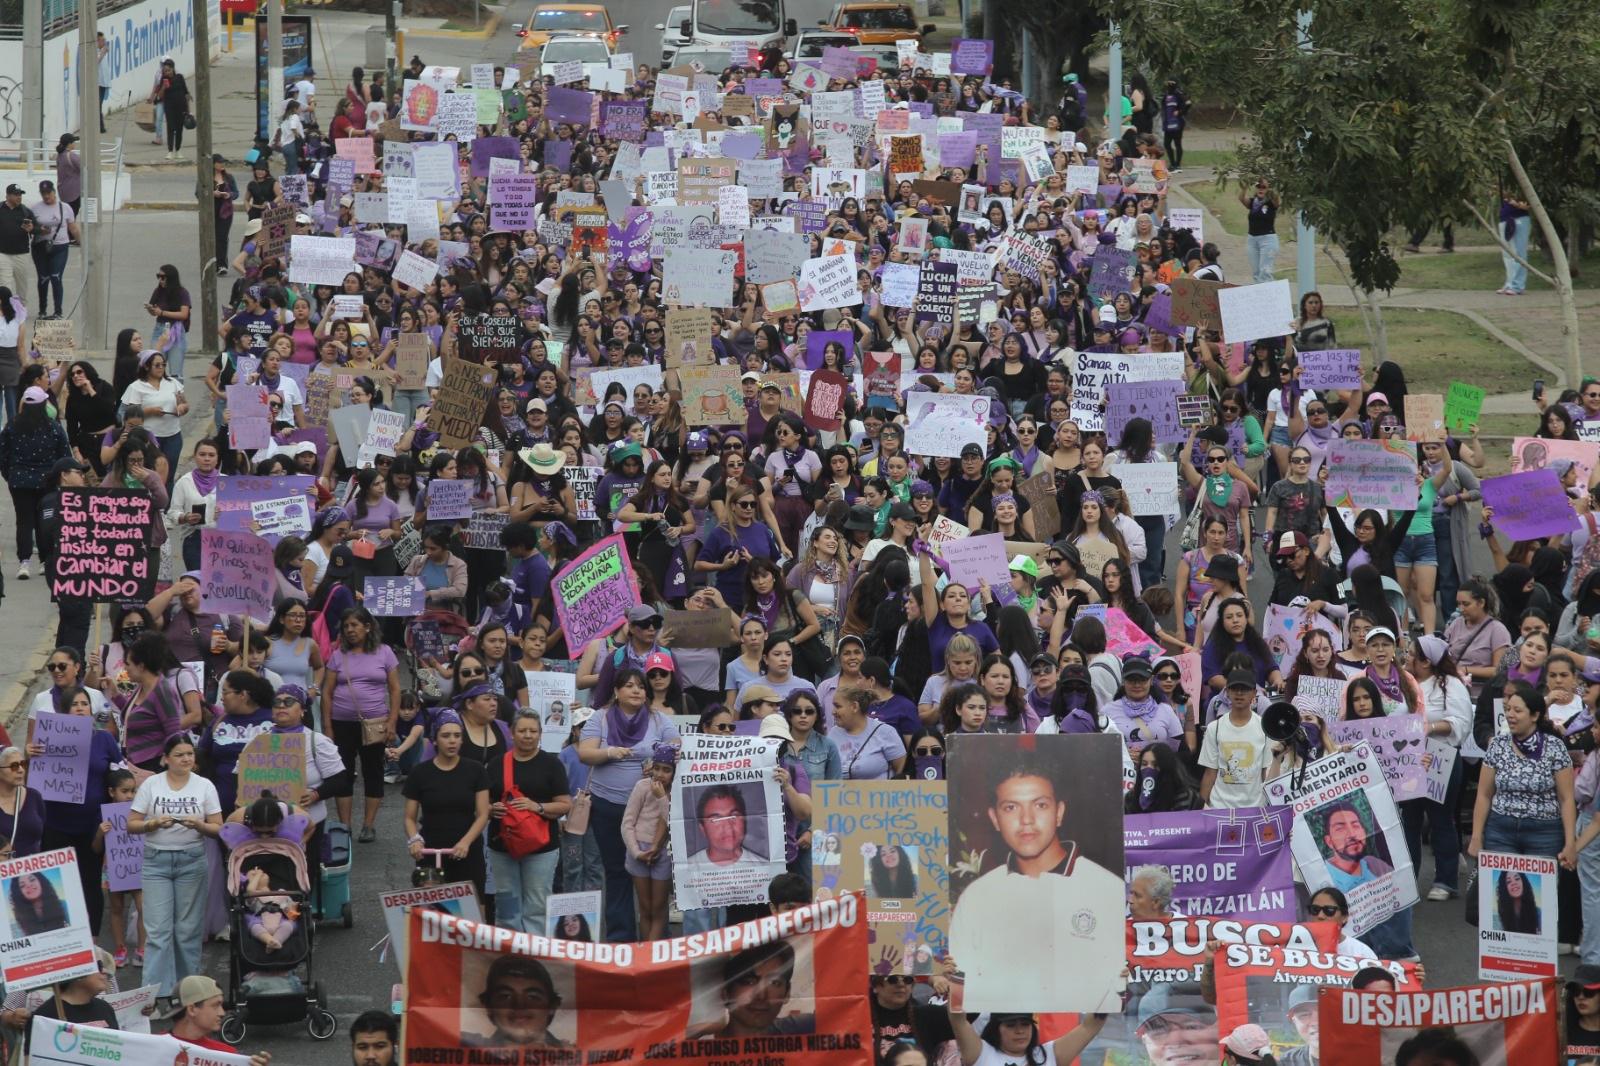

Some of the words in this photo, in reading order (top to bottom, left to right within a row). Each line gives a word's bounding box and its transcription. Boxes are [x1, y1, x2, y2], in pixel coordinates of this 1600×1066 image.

[125, 8, 184, 73] Remington,
[609, 106, 623, 115] NO
[626, 106, 643, 115] ERA
[818, 257, 846, 272] MAÑANA
[921, 261, 934, 271] LA
[920, 271, 956, 283] LUCHA
[921, 284, 934, 293] ES
[937, 285, 951, 293] UN
[916, 304, 953, 315] COLECTI
[937, 314, 952, 323] VO
[462, 327, 475, 336] UN
[498, 326, 516, 336] QUE
[471, 336, 517, 348] SIEMBRA
[1118, 363, 1130, 372] en
[1075, 373, 1097, 387] VOZ
[1073, 389, 1099, 400] evita
[439, 414, 479, 444] MIEDO
[61, 491, 82, 507] Es
[89, 495, 128, 512] porque
[129, 496, 151, 512] soy
[60, 507, 87, 523] tan
[89, 507, 150, 525] testaruda
[60, 525, 87, 541] que
[60, 538, 108, 555] insisto
[115, 544, 135, 557] en
[57, 557, 130, 576] Cambiar
[132, 558, 148, 578] el
[559, 559, 595, 595] QUIERO
[595, 546, 617, 566] QUE
[53, 578, 139, 598] MUNDO
[565, 581, 587, 600] TODA
[587, 562, 613, 587] NIÑA
[573, 613, 608, 645] MUNDO
[697, 738, 752, 749] DEUDOR
[680, 746, 767, 761] ALIMENTARIO
[690, 759, 752, 773] AGRESOR
[1294, 755, 1347, 785] DEUDOR
[681, 772, 717, 785] EDGAR
[720, 769, 764, 782] ADRIAN
[1283, 761, 1368, 805] ALIMENTARIO
[815, 783, 862, 808] Tía
[869, 789, 948, 809] mientra
[1319, 774, 1370, 803] RODRIGO
[110, 813, 128, 831] NO
[828, 812, 857, 836] no
[860, 808, 919, 831] estés
[1149, 827, 1192, 836] PRESENTE
[887, 827, 948, 848] nosotr
[110, 848, 142, 861] PARA
[1480, 853, 1556, 875] DESAPARECIDA
[1213, 862, 1237, 881] DE
[383, 885, 474, 909] DESAPARECIDA
[1187, 887, 1285, 916] MAZATLÁN
[866, 912, 918, 922] DESAPARECIDA
[421, 910, 633, 968] DESAPARECIDO
[652, 894, 857, 964] DESAPARECIDO
[1132, 919, 1319, 957] BUSCA
[1480, 930, 1507, 943] CHINA
[0, 937, 32, 953] CHINA
[1226, 944, 1275, 968] SE
[1283, 948, 1409, 985] BUSCA
[1273, 968, 1323, 985] Álvaro
[1326, 973, 1352, 987] Riv
[1342, 981, 1547, 1027] DESAPARECIDA
[79, 1040, 122, 1062] Sinaloa
[644, 1038, 677, 1059] JOSÉ
[681, 1038, 741, 1058] ALFONSO
[744, 1036, 803, 1054] ASTORGA
[807, 1033, 862, 1052] NIEBLAS
[408, 1047, 466, 1066] ROBERTO
[468, 1047, 520, 1066] ALONSO
[524, 1048, 583, 1066] ASTORGA
